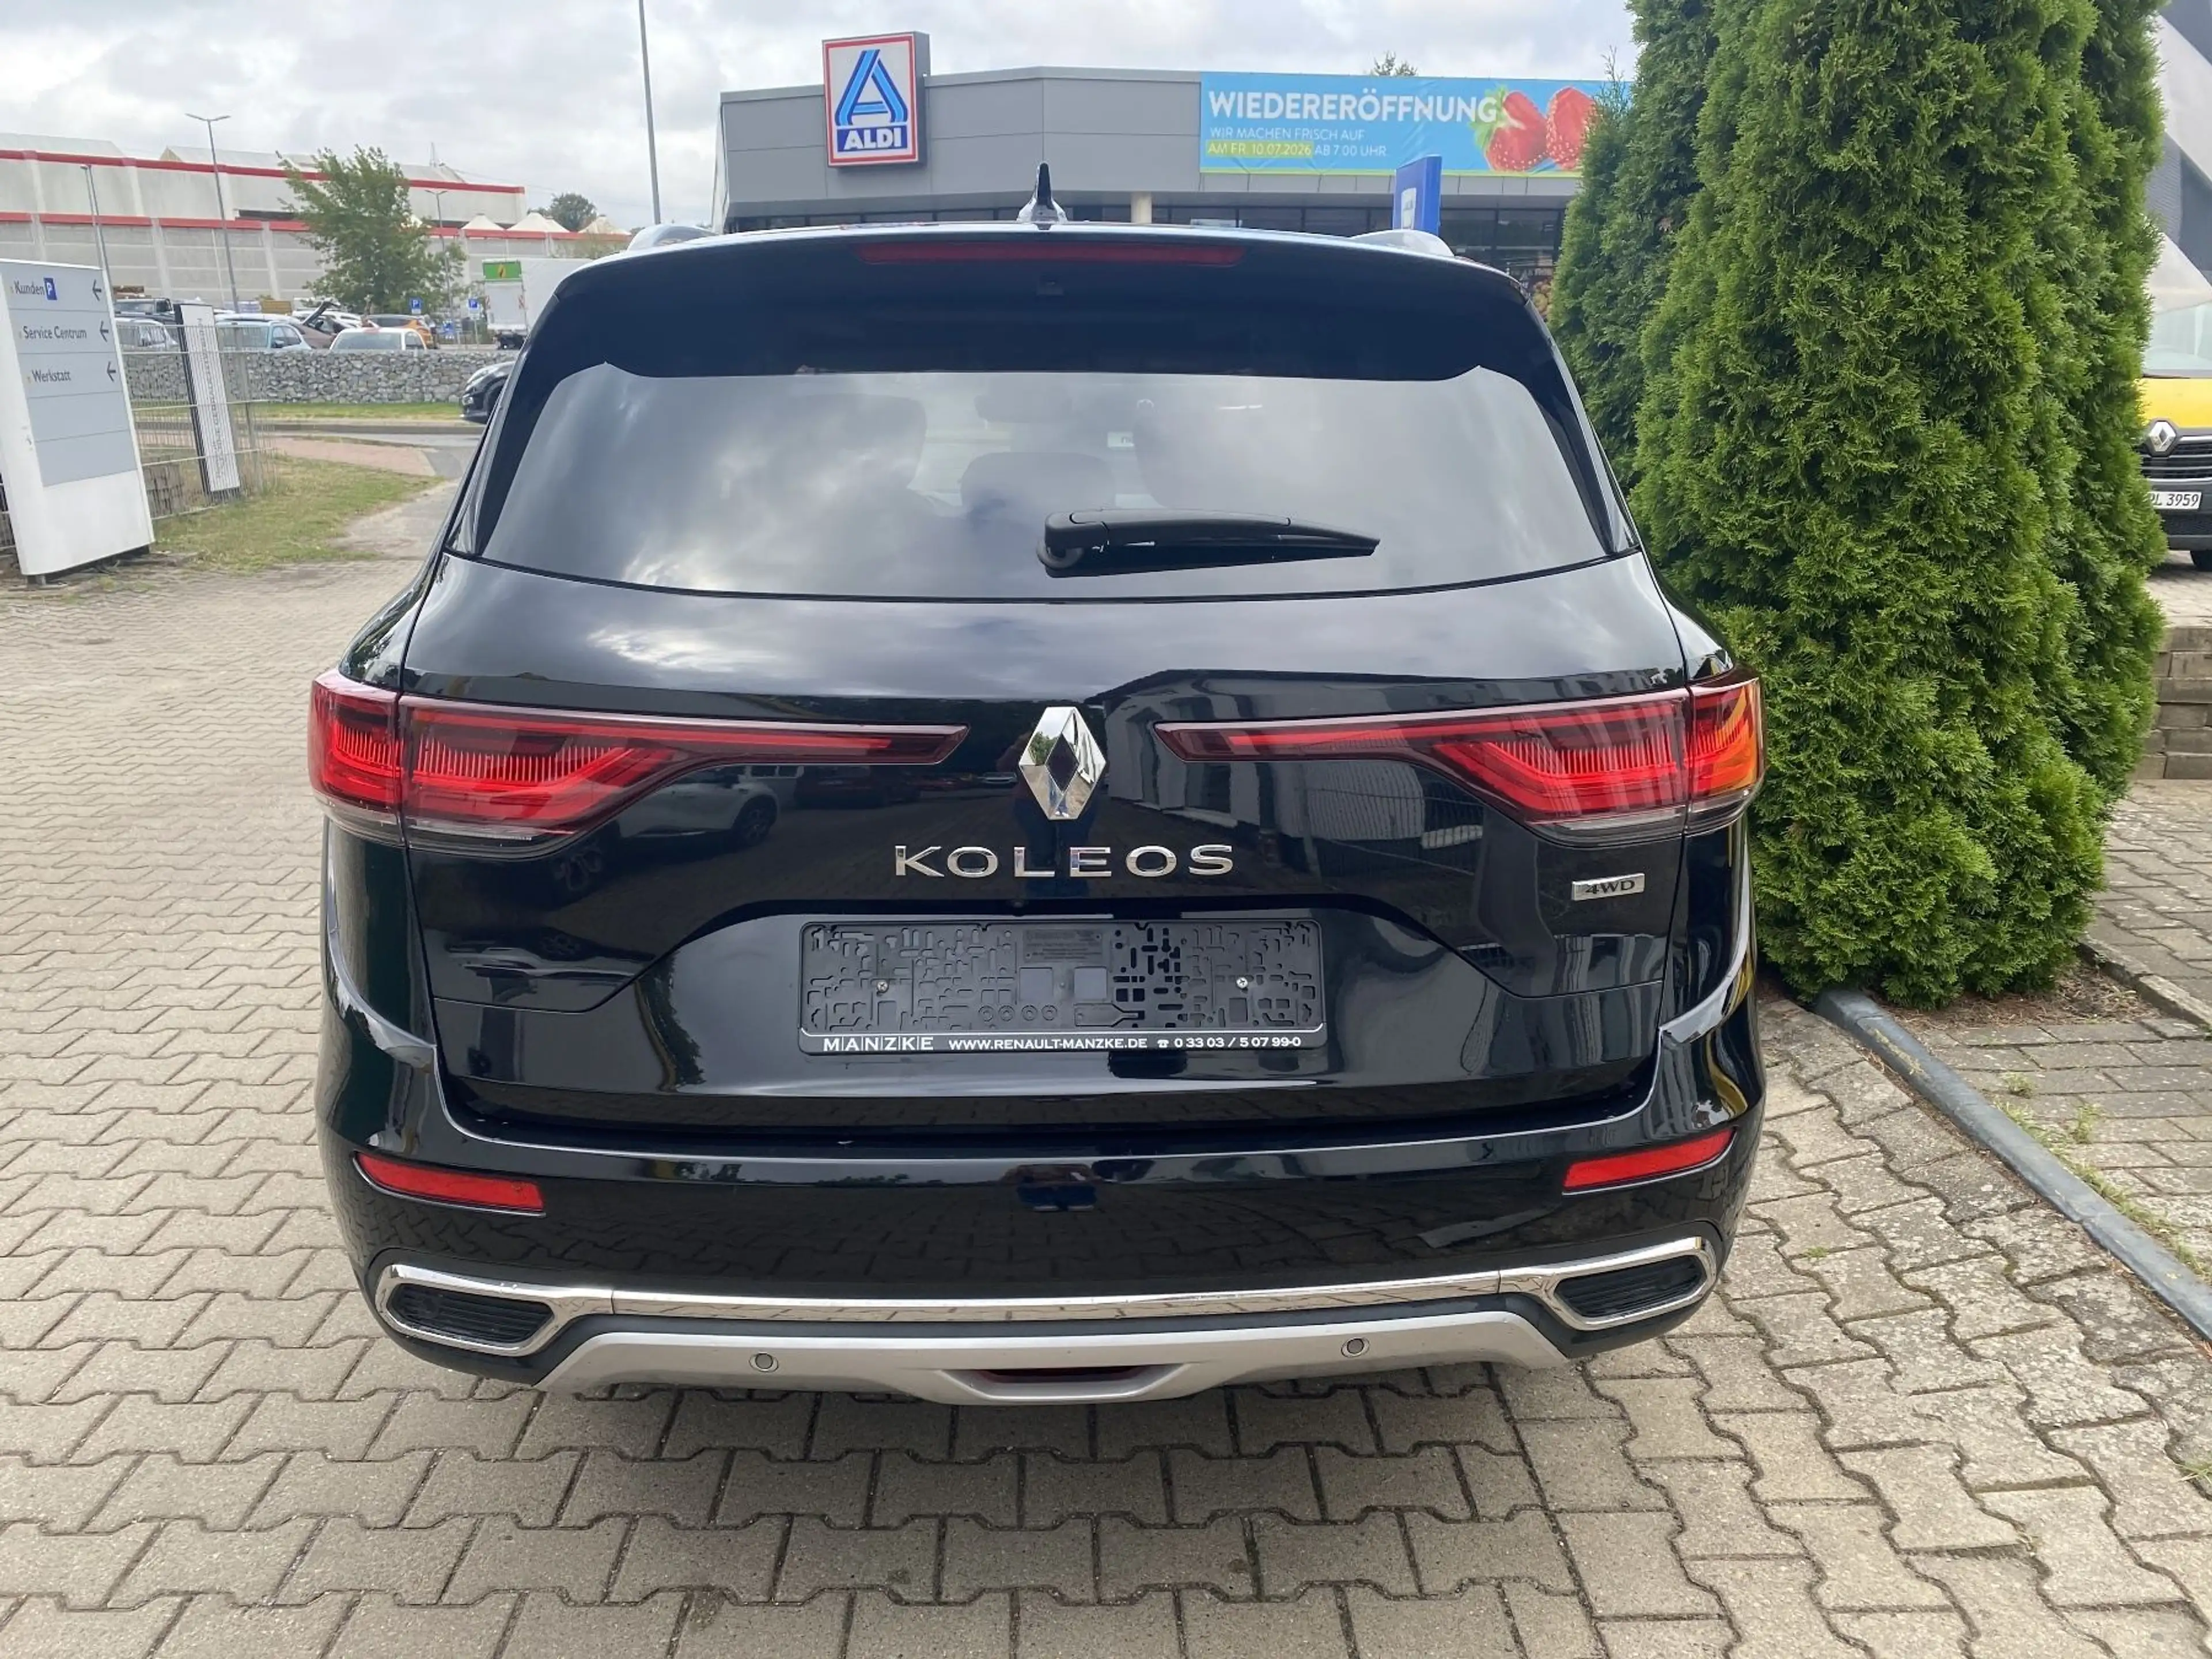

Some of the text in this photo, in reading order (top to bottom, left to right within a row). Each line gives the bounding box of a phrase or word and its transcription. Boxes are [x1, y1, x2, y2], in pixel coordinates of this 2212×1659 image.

[1209, 88, 1497, 123] WIEDERERÖFFNUNG
[843, 127, 902, 150] ALDI
[1210, 127, 1365, 141] WIR MACHEN FRISCH AUF
[1208, 143, 1228, 154] AM
[1315, 145, 1331, 156] AB
[1361, 145, 1387, 157] UHR
[14, 280, 46, 295] Kunden
[23, 325, 87, 339] Service Centrum
[31, 369, 71, 382] Werkstatt
[2166, 494, 2199, 506] 3959
[895, 845, 1233, 877] KOLEOS
[1585, 880, 1635, 894] 4WD
[949, 1038, 1147, 1050] WWW.RENAULT-MANZKE.DE
[1272, 1037, 1302, 1047] 99-0
